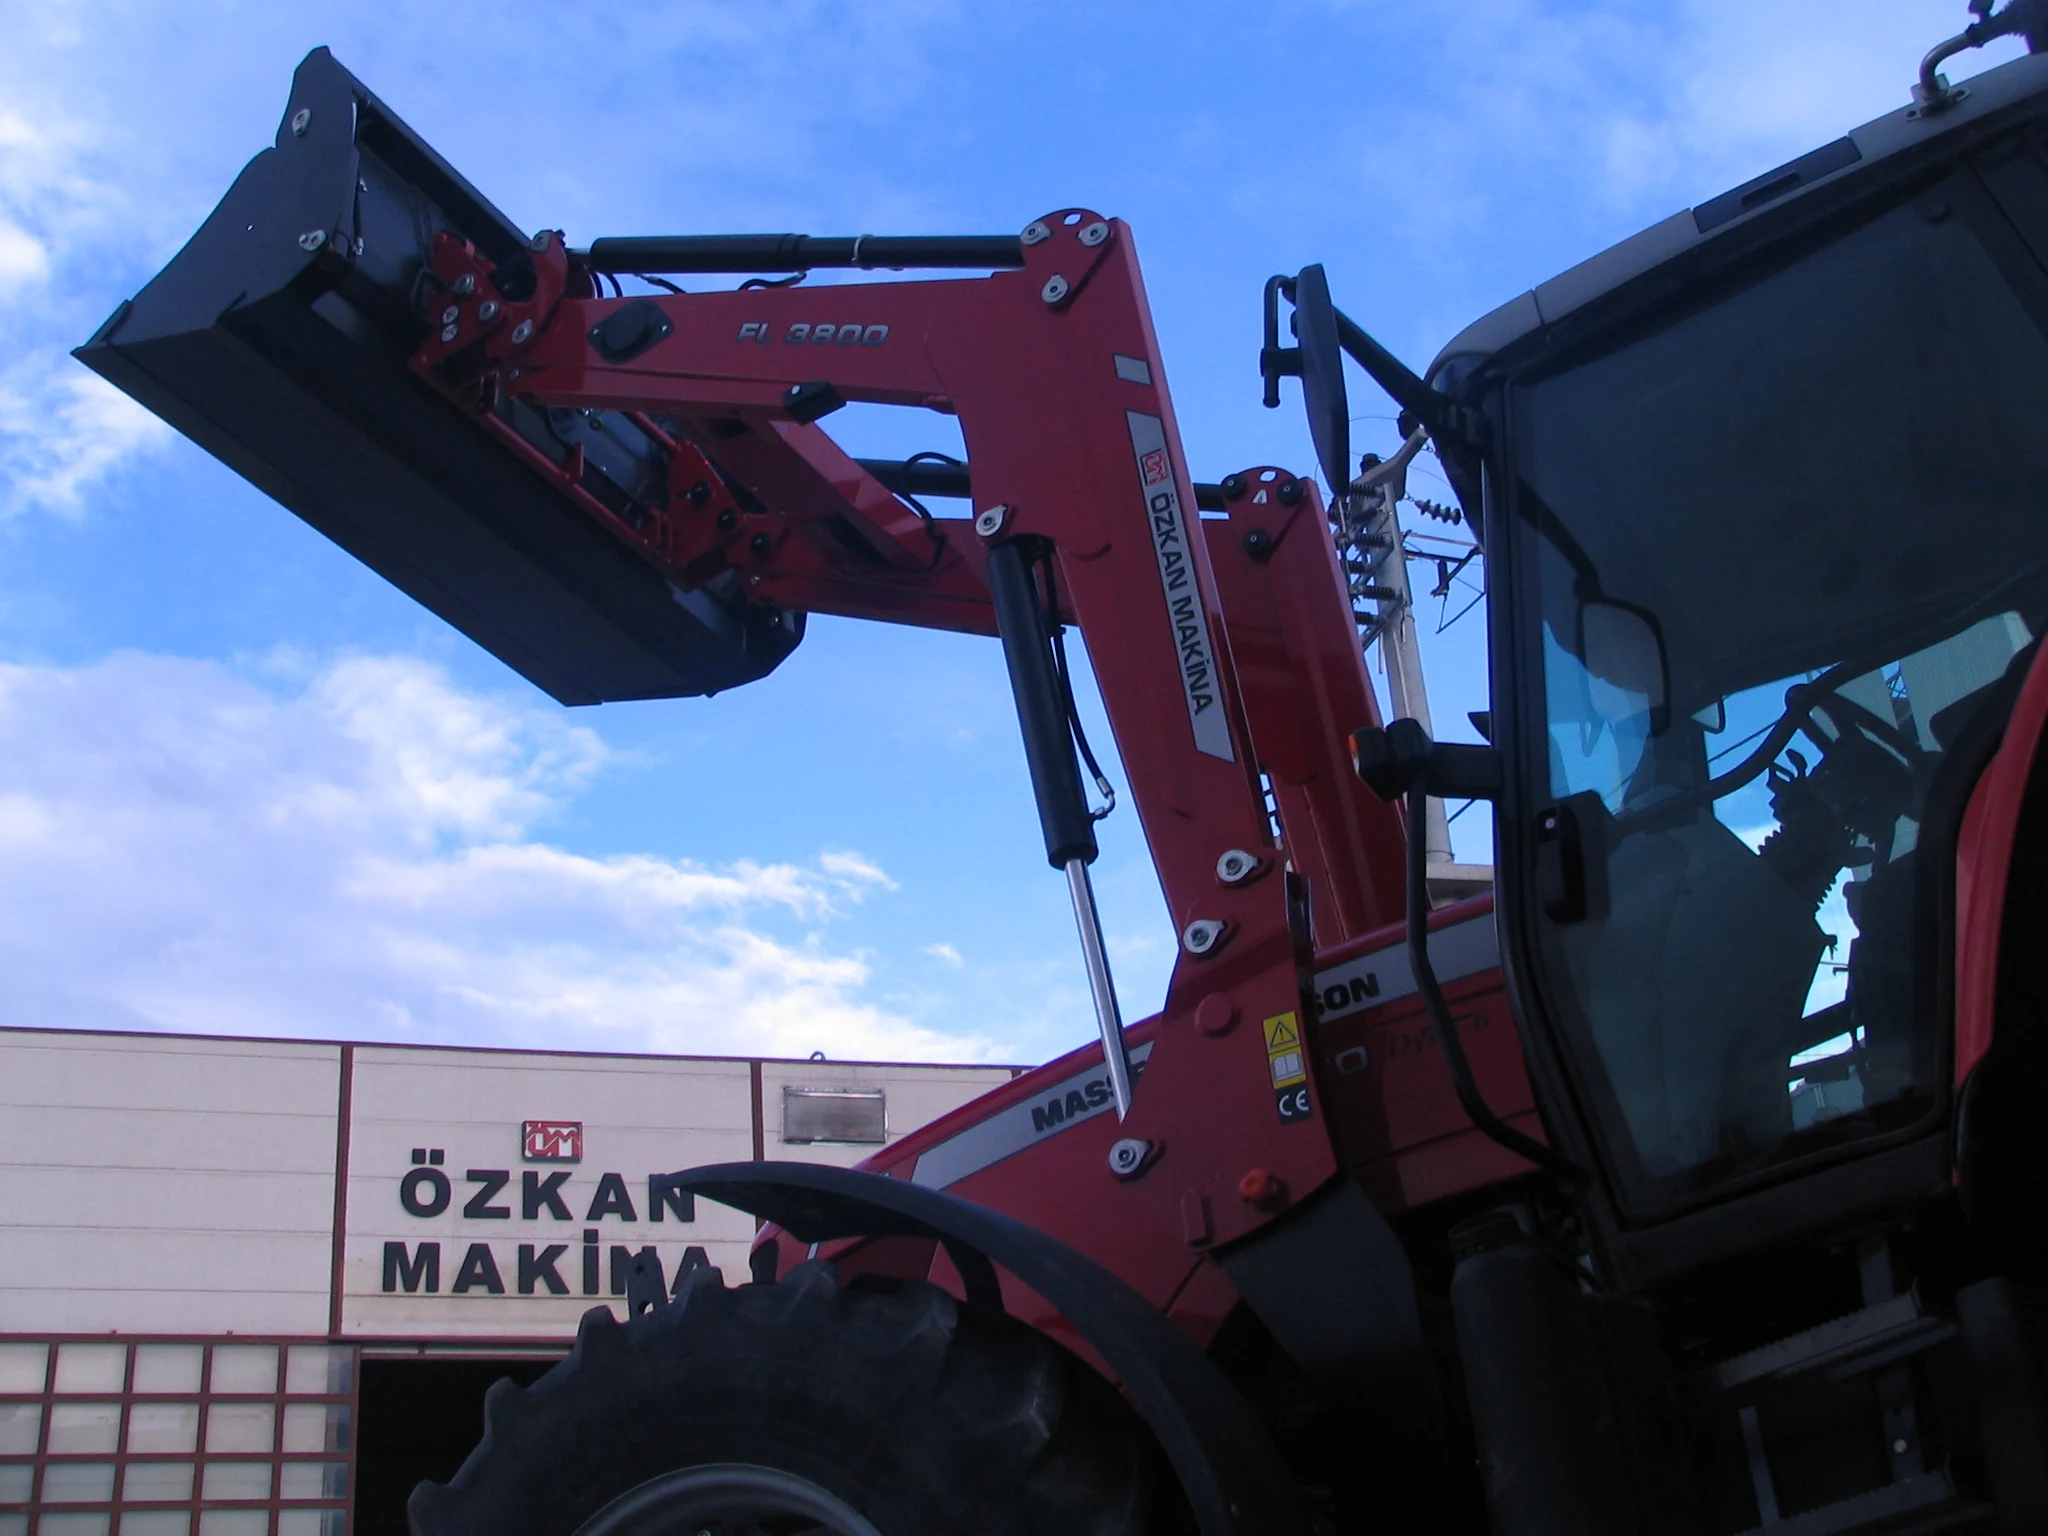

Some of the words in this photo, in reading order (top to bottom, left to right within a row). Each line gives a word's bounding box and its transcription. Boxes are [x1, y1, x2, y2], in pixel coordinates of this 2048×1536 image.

[735, 322, 774, 344] FL
[784, 323, 890, 346] 3800
[1150, 492, 1188, 592] ÖZKAN
[1171, 594, 1214, 717] MAKİNA
[400, 1147, 696, 1222] ÖZKAN
